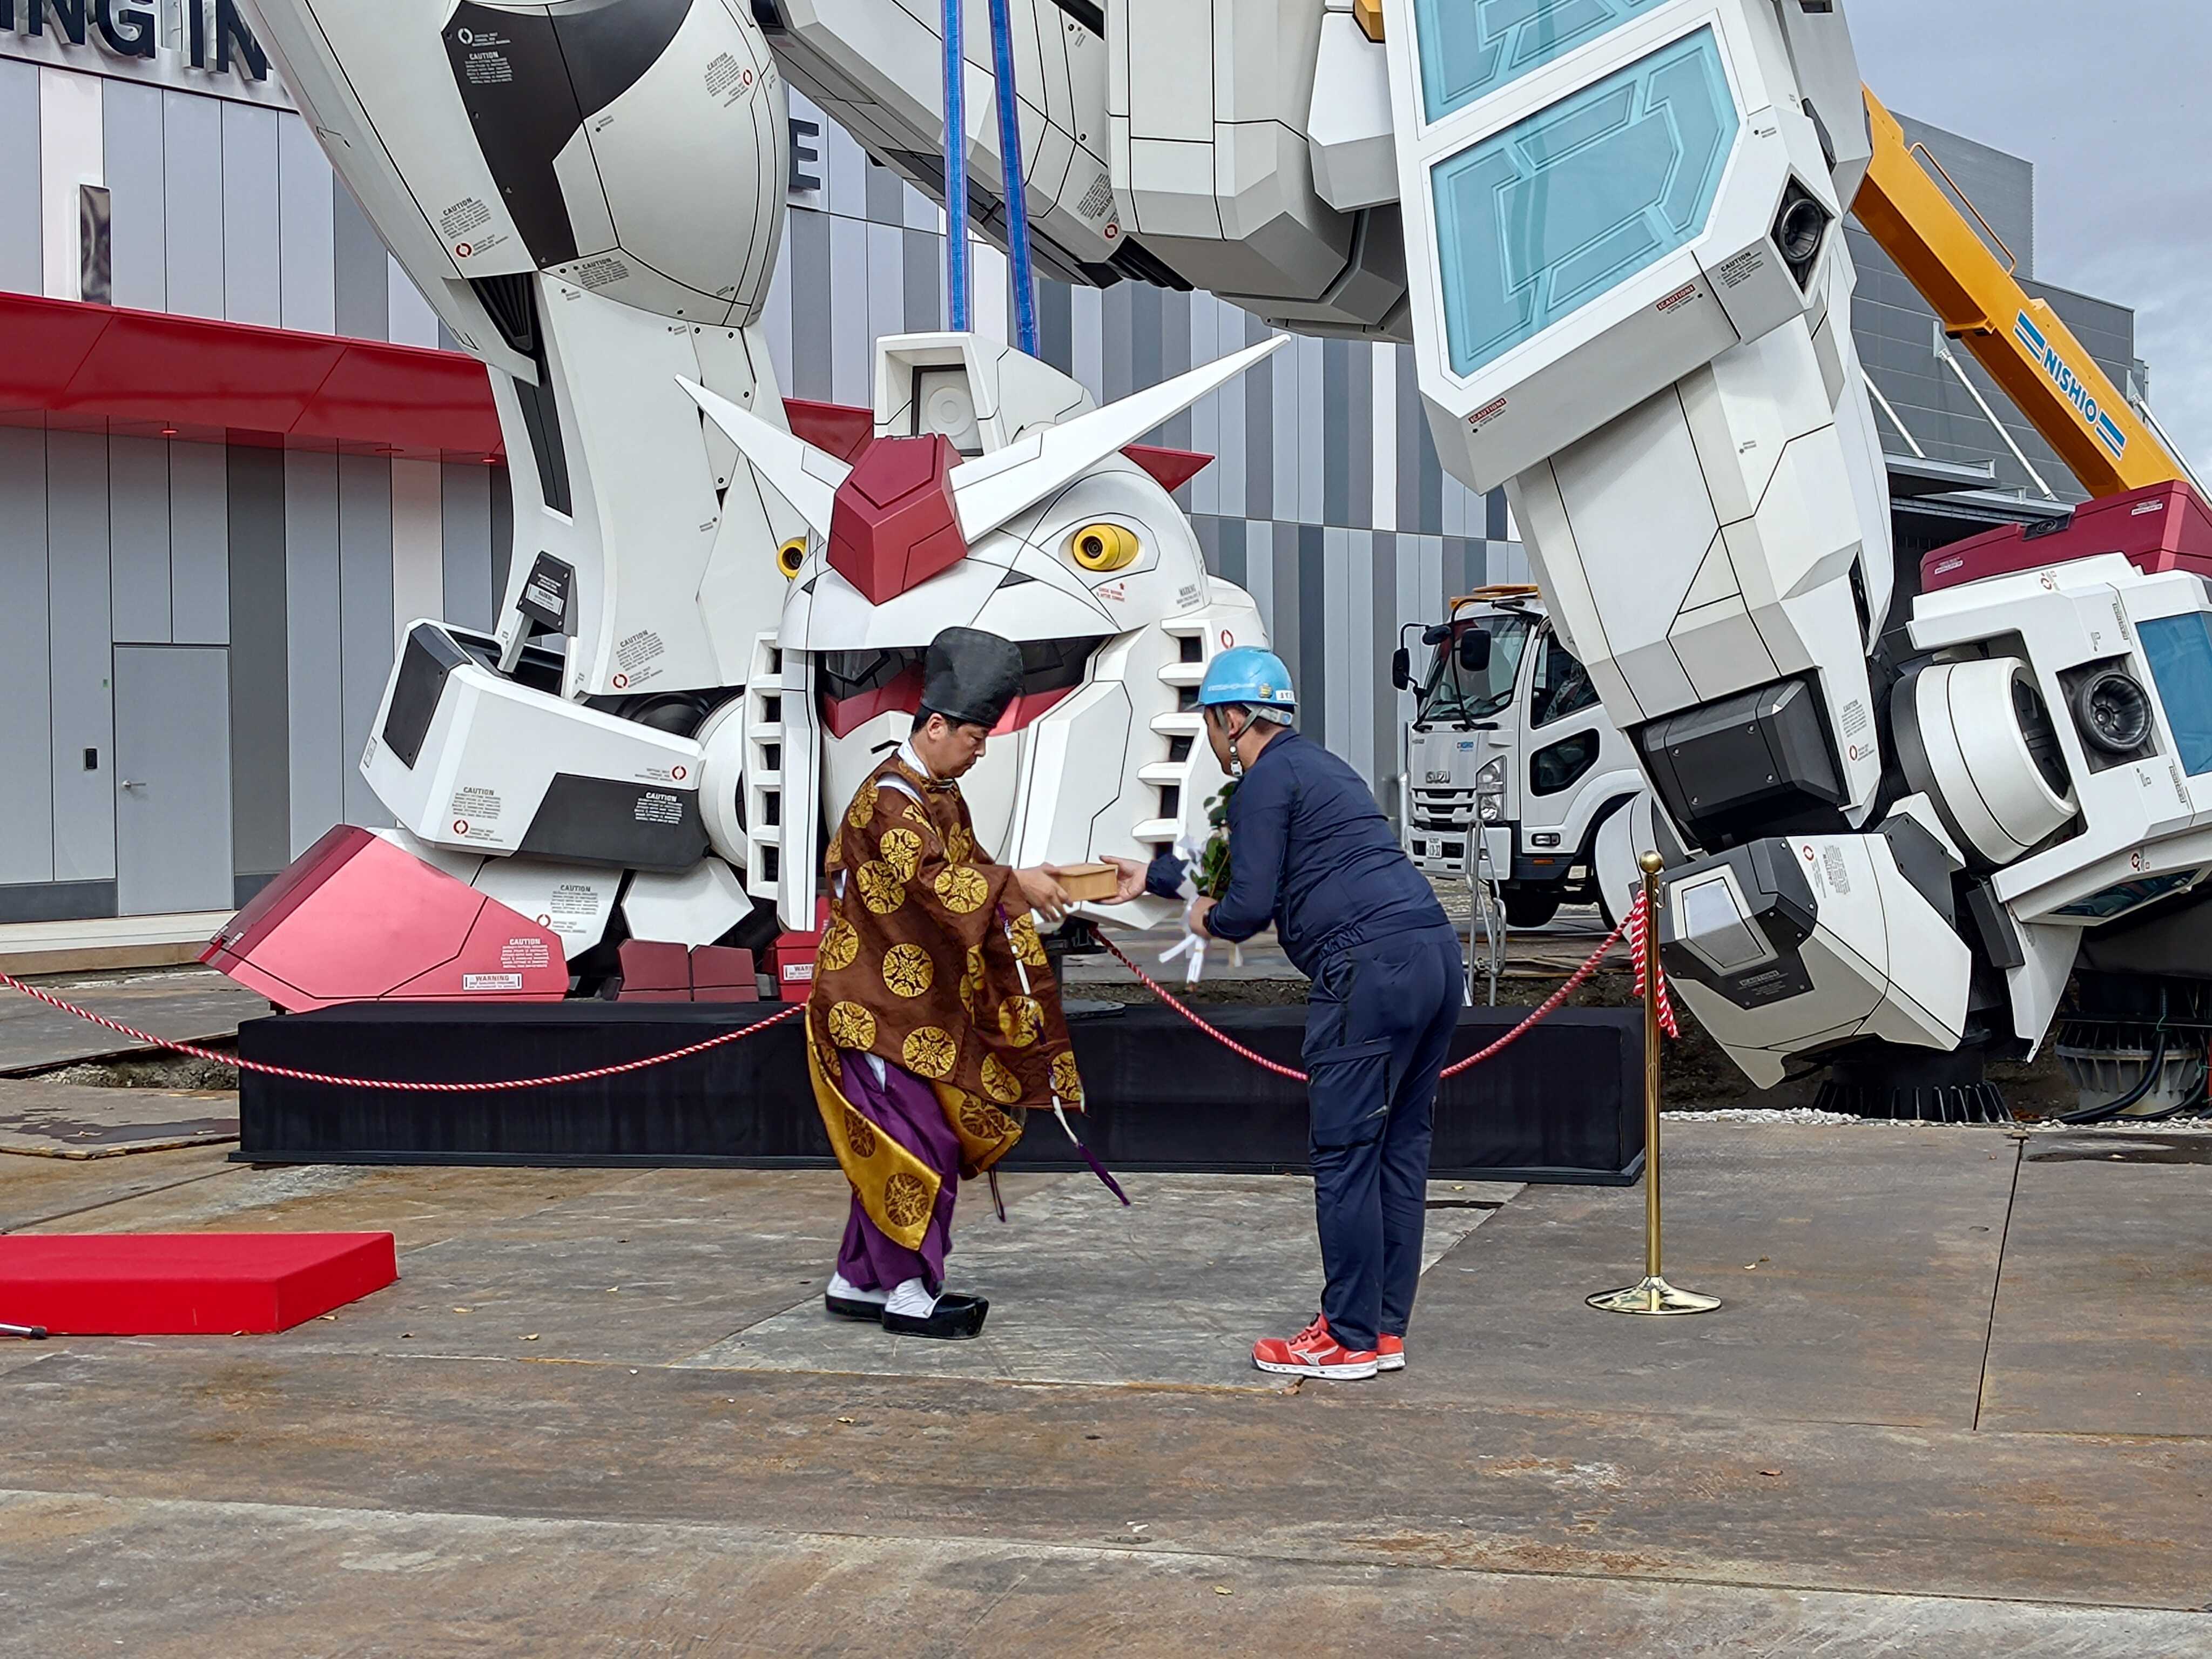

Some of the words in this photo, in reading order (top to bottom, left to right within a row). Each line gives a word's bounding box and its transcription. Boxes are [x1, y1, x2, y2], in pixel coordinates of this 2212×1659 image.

[469, 51, 499, 60] CAUTION
[789, 118, 821, 190] E
[443, 197, 473, 216] CAUTION
[582, 258, 612, 269] CAUTION
[1721, 252, 1751, 272] CAUTION
[2043, 346, 2098, 423] NISHIO
[620, 630, 648, 648] CAUTION
[463, 787, 494, 795] CAUTION
[645, 792, 677, 802] CAUTION
